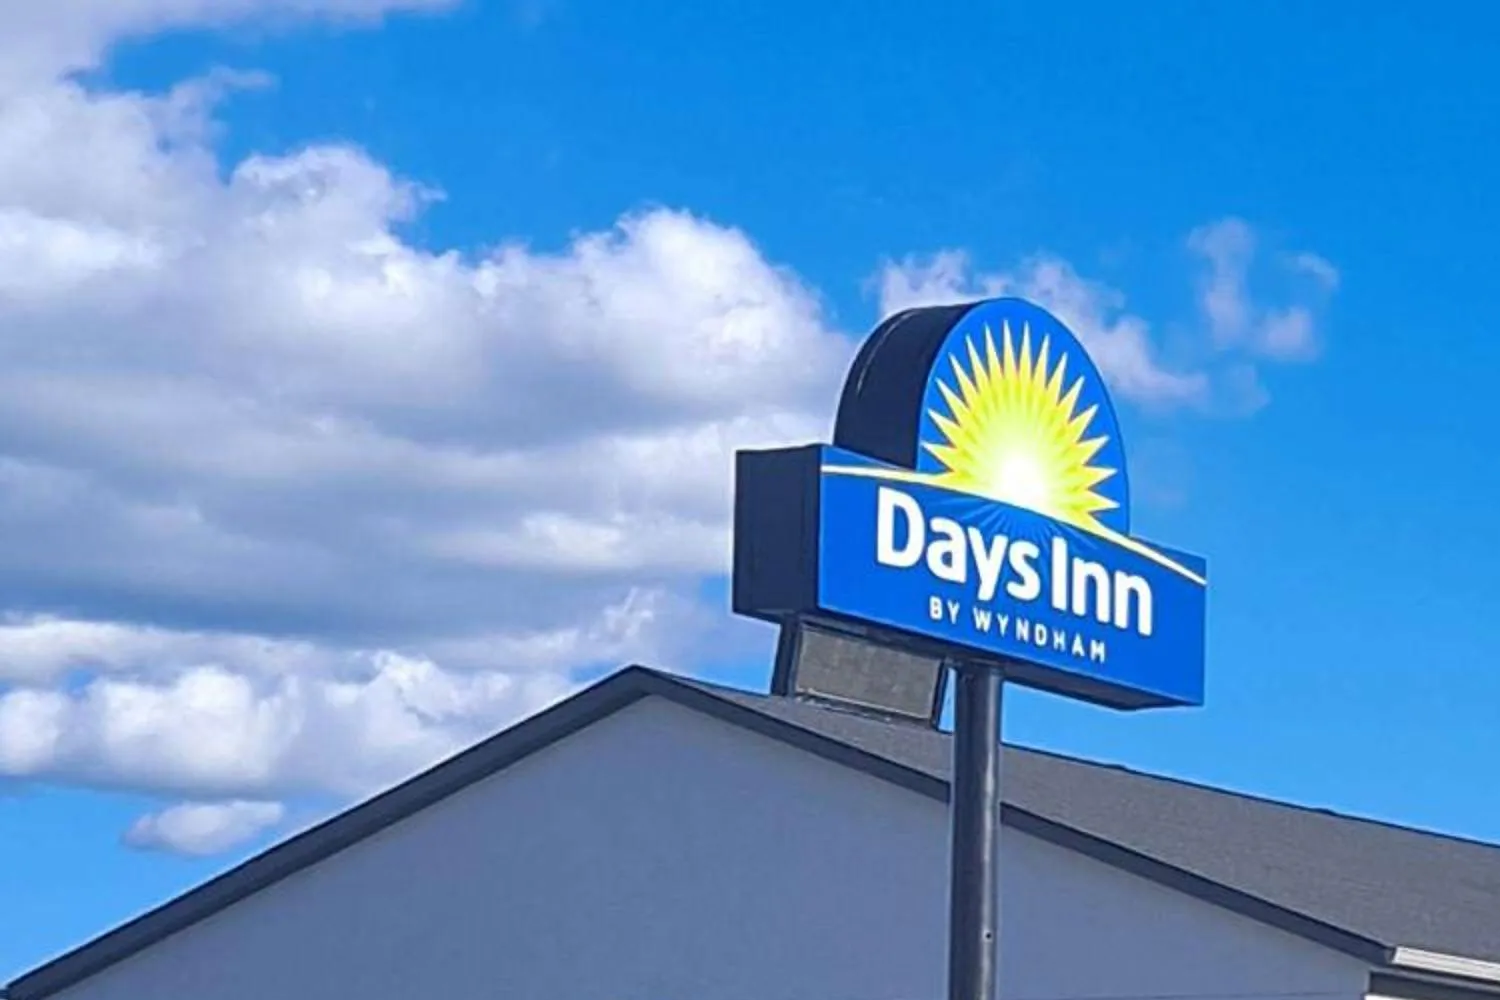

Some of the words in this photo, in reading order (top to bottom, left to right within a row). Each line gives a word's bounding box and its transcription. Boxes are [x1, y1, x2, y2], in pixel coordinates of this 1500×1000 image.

[877, 485, 1041, 601] Days
[1051, 535, 1152, 637] Inn
[929, 595, 960, 625] BY
[973, 606, 1105, 664] WYNDHAM
